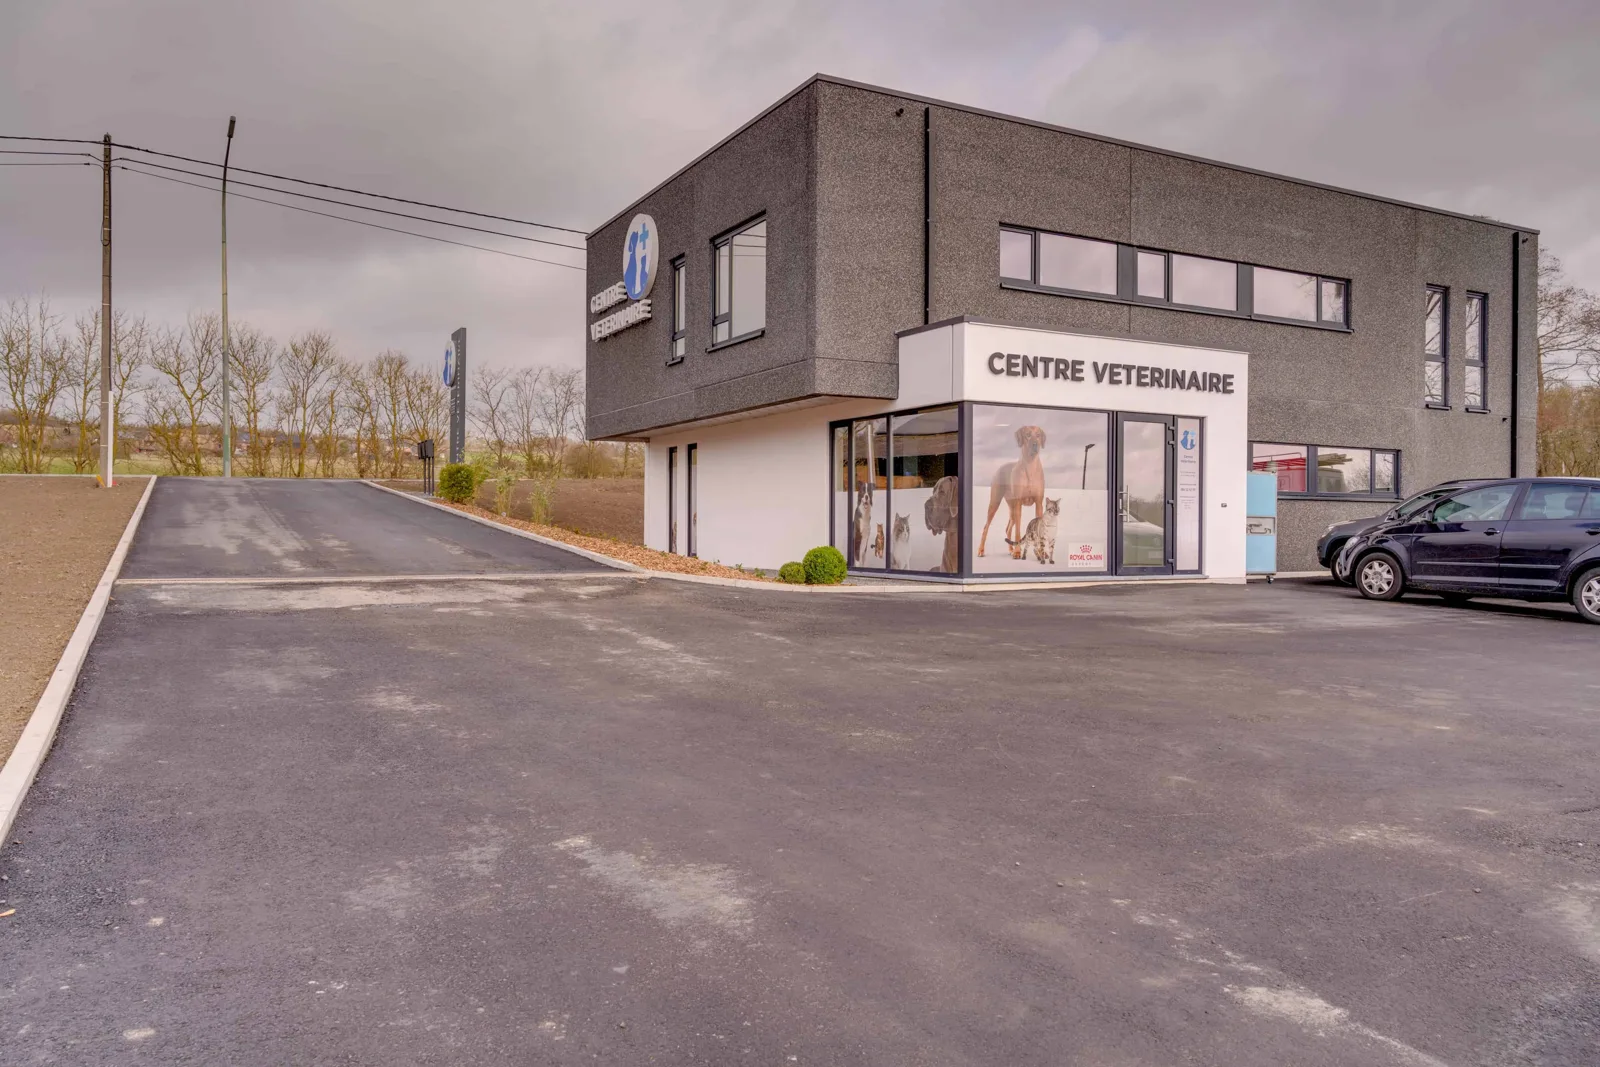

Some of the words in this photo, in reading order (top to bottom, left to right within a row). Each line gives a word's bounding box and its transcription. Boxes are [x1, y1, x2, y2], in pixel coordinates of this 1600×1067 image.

[591, 299, 652, 342] VETERINAIRE
[987, 352, 1085, 382] CENTRE
[1093, 361, 1235, 394] VETERINAIRE
